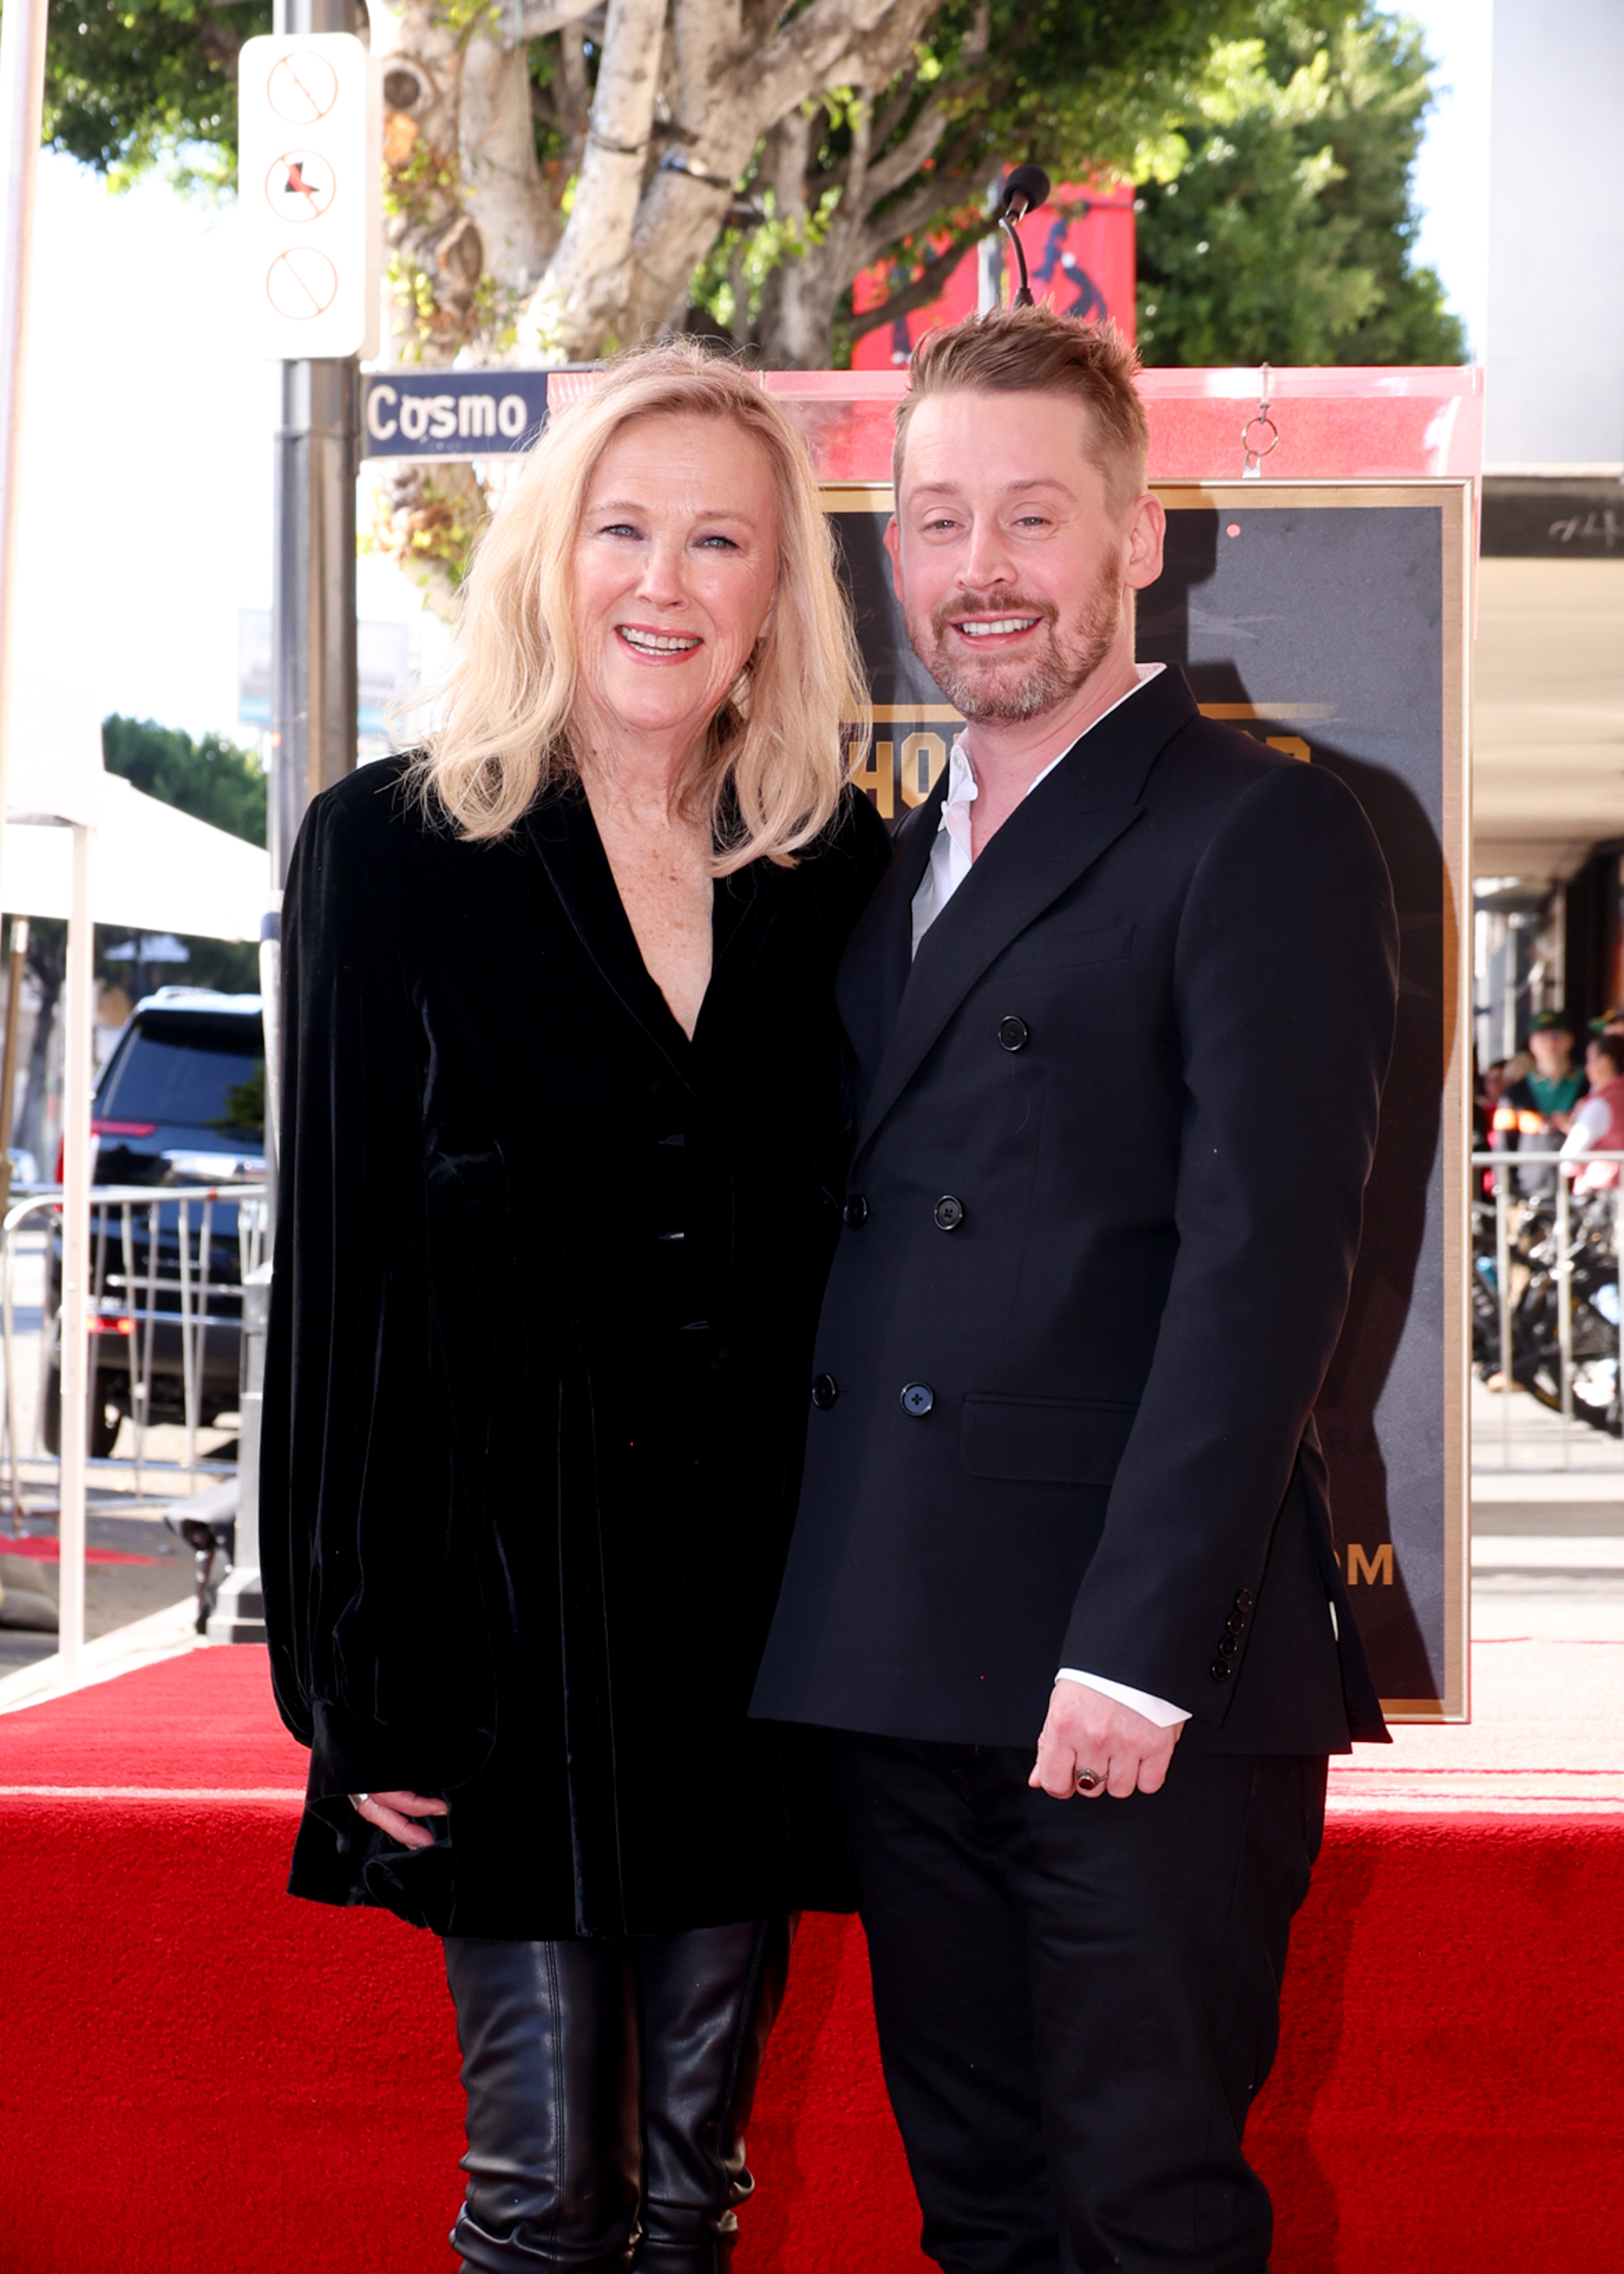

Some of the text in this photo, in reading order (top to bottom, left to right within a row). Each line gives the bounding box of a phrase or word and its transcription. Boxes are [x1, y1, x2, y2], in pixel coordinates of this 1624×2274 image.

[368, 384, 528, 440] Cosmo
[849, 732, 961, 819] HO
[1333, 1543, 1393, 1585] M
